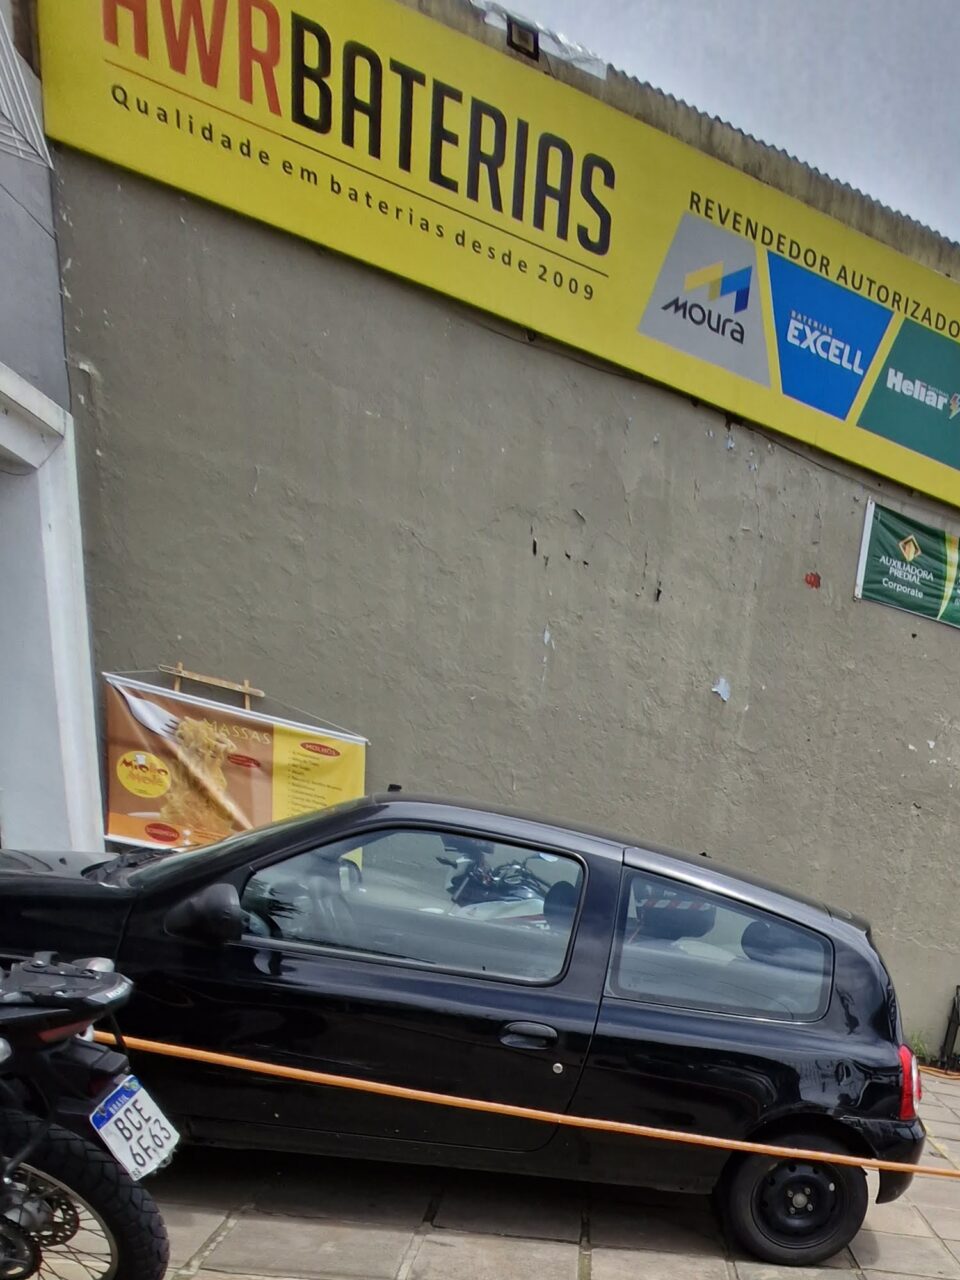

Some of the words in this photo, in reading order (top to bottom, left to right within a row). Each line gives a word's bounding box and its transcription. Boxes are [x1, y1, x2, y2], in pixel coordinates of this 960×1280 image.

[110, 84, 270, 166] Qualidade
[282, 157, 318, 186] em
[330, 174, 444, 238] baterias
[455, 229, 528, 273] desde
[537, 264, 594, 301] 2009
[689, 190, 830, 276] REVENDEDOR
[791, 310, 833, 335] BATERIAS
[786, 318, 864, 376] EXCELL
[886, 367, 949, 411] Heliar
[879, 555, 934, 581] AUXILIADORA
[882, 578, 923, 598] Corporate
[889, 568, 921, 585] PREDIAL
[108, 1094, 130, 1116] BRASIL
[113, 1099, 151, 1142] BCE
[129, 1118, 171, 1168] 6F63
